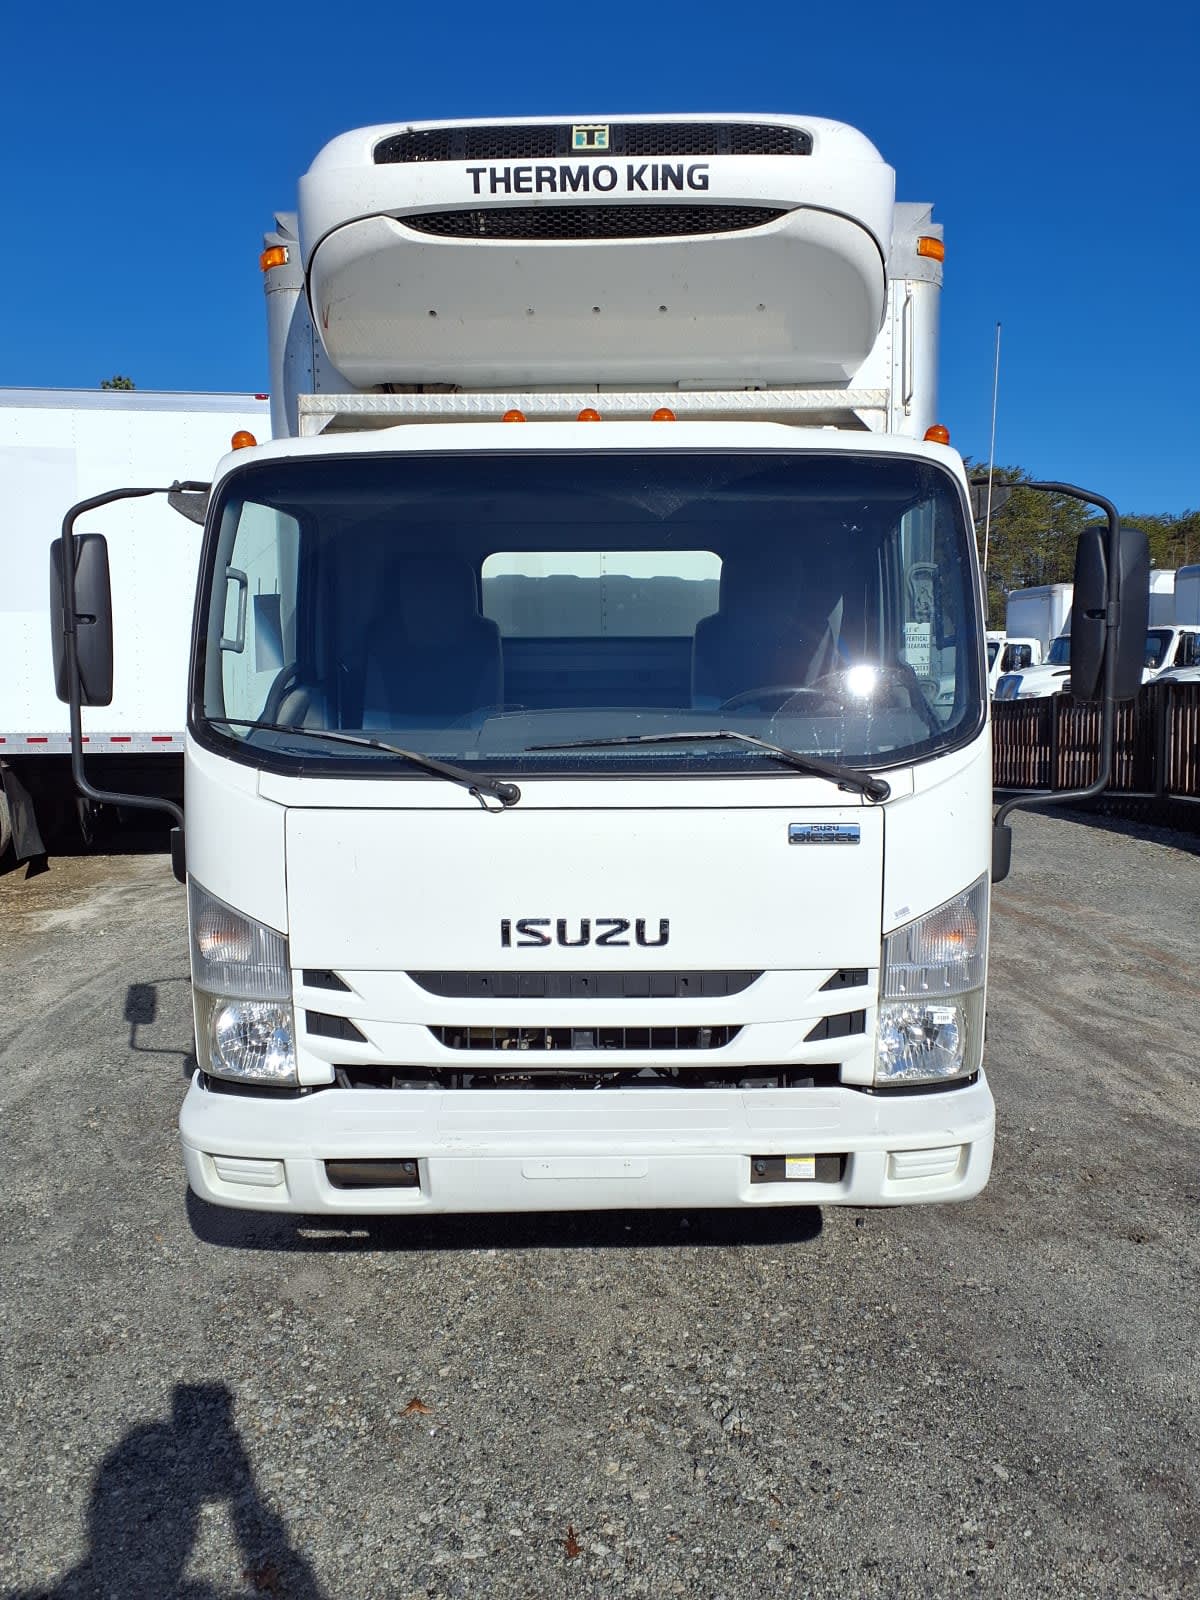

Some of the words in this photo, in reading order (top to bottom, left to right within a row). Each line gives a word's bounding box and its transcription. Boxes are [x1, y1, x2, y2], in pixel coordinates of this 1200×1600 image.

[466, 165, 618, 194] THERMO
[626, 164, 709, 191] KING
[501, 918, 669, 948] ISUZU
